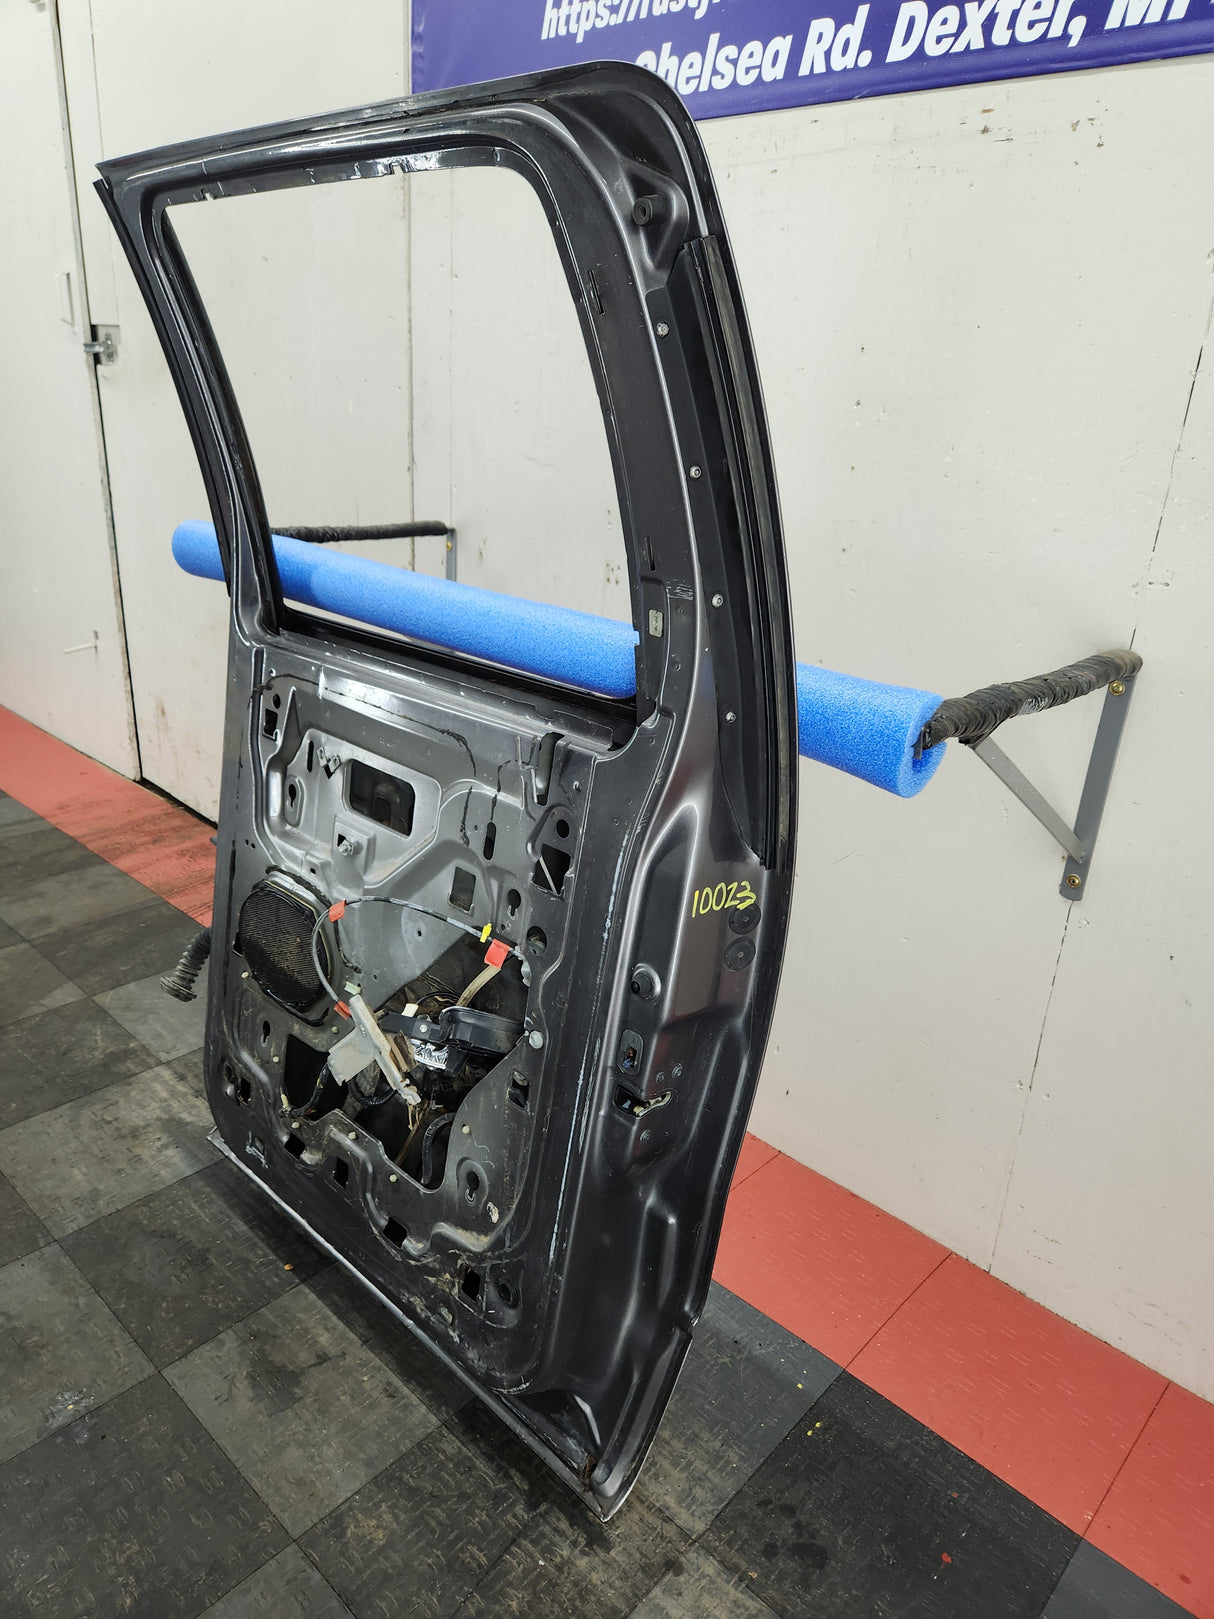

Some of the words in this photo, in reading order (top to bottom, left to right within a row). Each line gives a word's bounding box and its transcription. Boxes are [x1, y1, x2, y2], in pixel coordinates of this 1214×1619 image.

[798, 3, 873, 77] Rd.
[885, 0, 1087, 47] Dexter,
[691, 880, 757, 918] 10023
